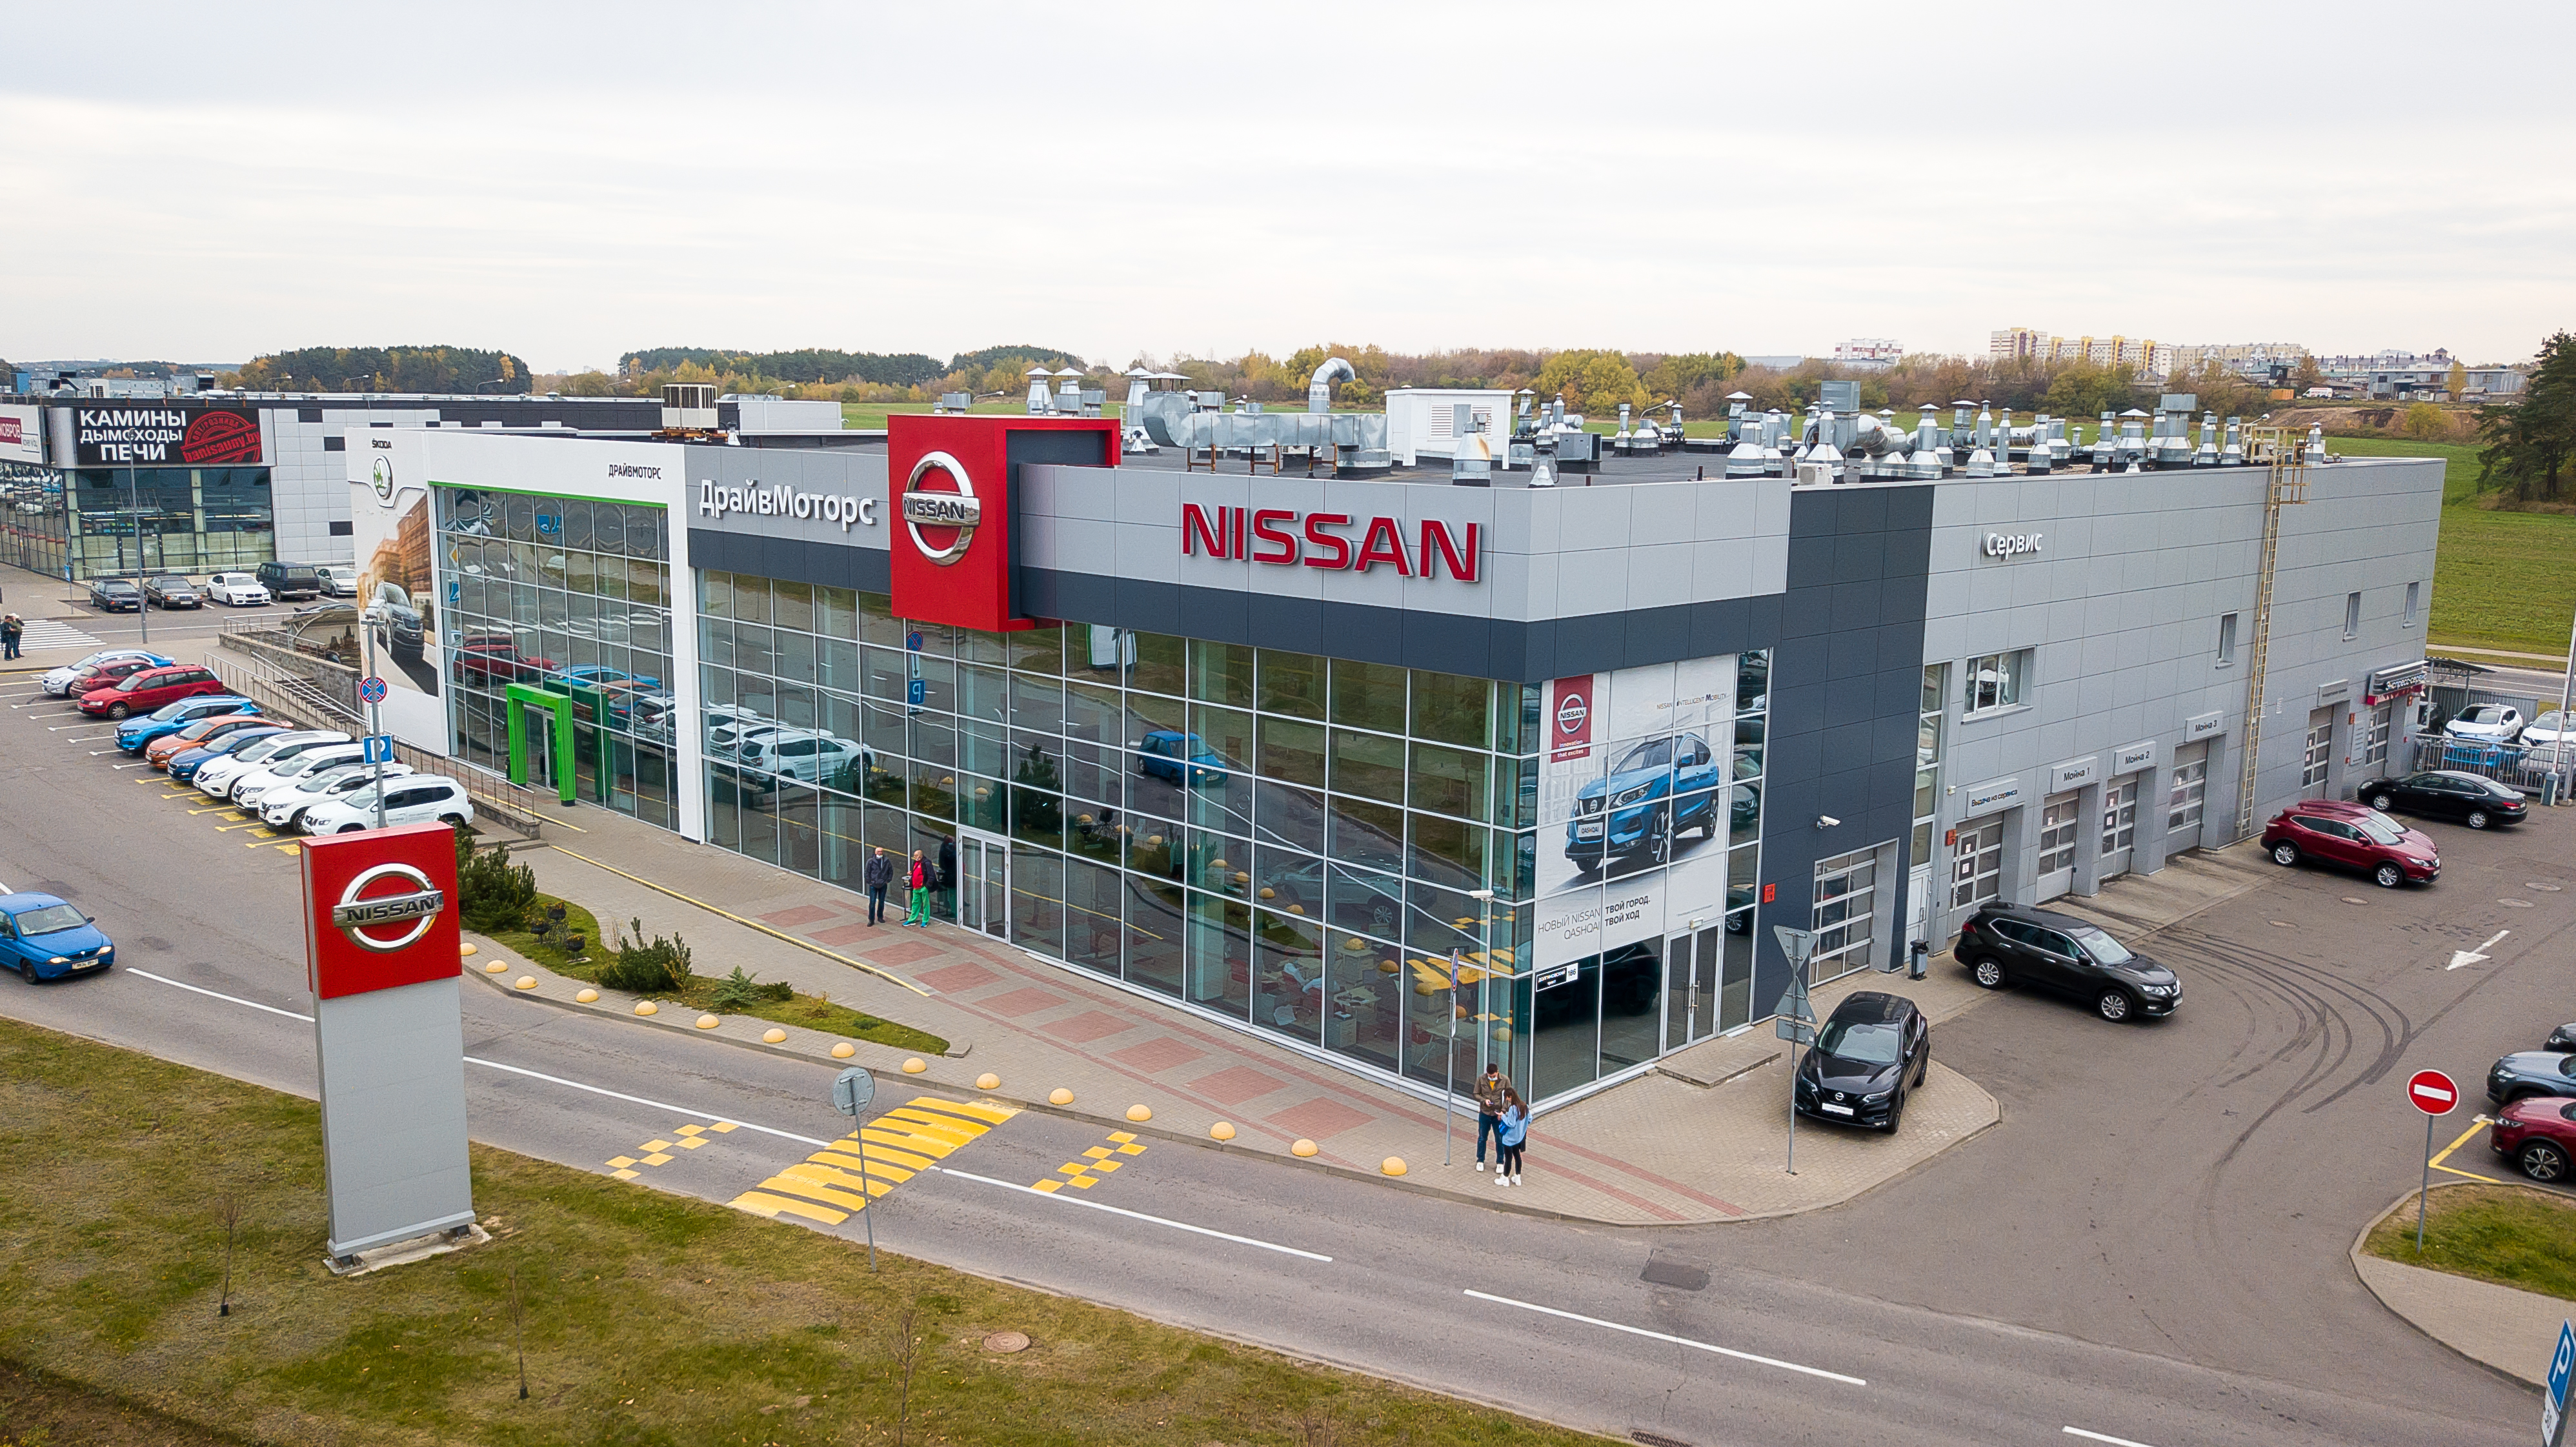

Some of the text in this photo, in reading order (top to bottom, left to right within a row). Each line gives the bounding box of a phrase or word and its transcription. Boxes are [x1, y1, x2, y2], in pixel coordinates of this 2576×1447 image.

[80, 410, 186, 427] КАМИНЫ
[101, 443, 166, 461] ПЕЧИ
[183, 431, 260, 463] banisauny.by
[372, 438, 392, 450] ŠKODA
[609, 462, 661, 480] ДРАЙВМОТОРС
[699, 478, 876, 532] ДрайвМоторс
[903, 499, 965, 520] NISSAN
[1182, 503, 1482, 582] NISSAN
[1986, 532, 2043, 560] Сервис
[1560, 710, 1584, 719] NISSAN
[370, 739, 386, 762] P
[2125, 751, 2150, 765] Мойка 2
[2064, 767, 2090, 782] Мойка 1
[347, 897, 436, 922] NISSAN
[1605, 900, 1625, 915] ТВОЙ
[1538, 907, 1601, 934] НОВЫЙ NISSAN
[1605, 909, 1640, 927] ТВОЙ ХОД
[1564, 921, 1600, 940] QASHQAI
[1567, 968, 1576, 976] 186
[2552, 1333, 2571, 1383] P
